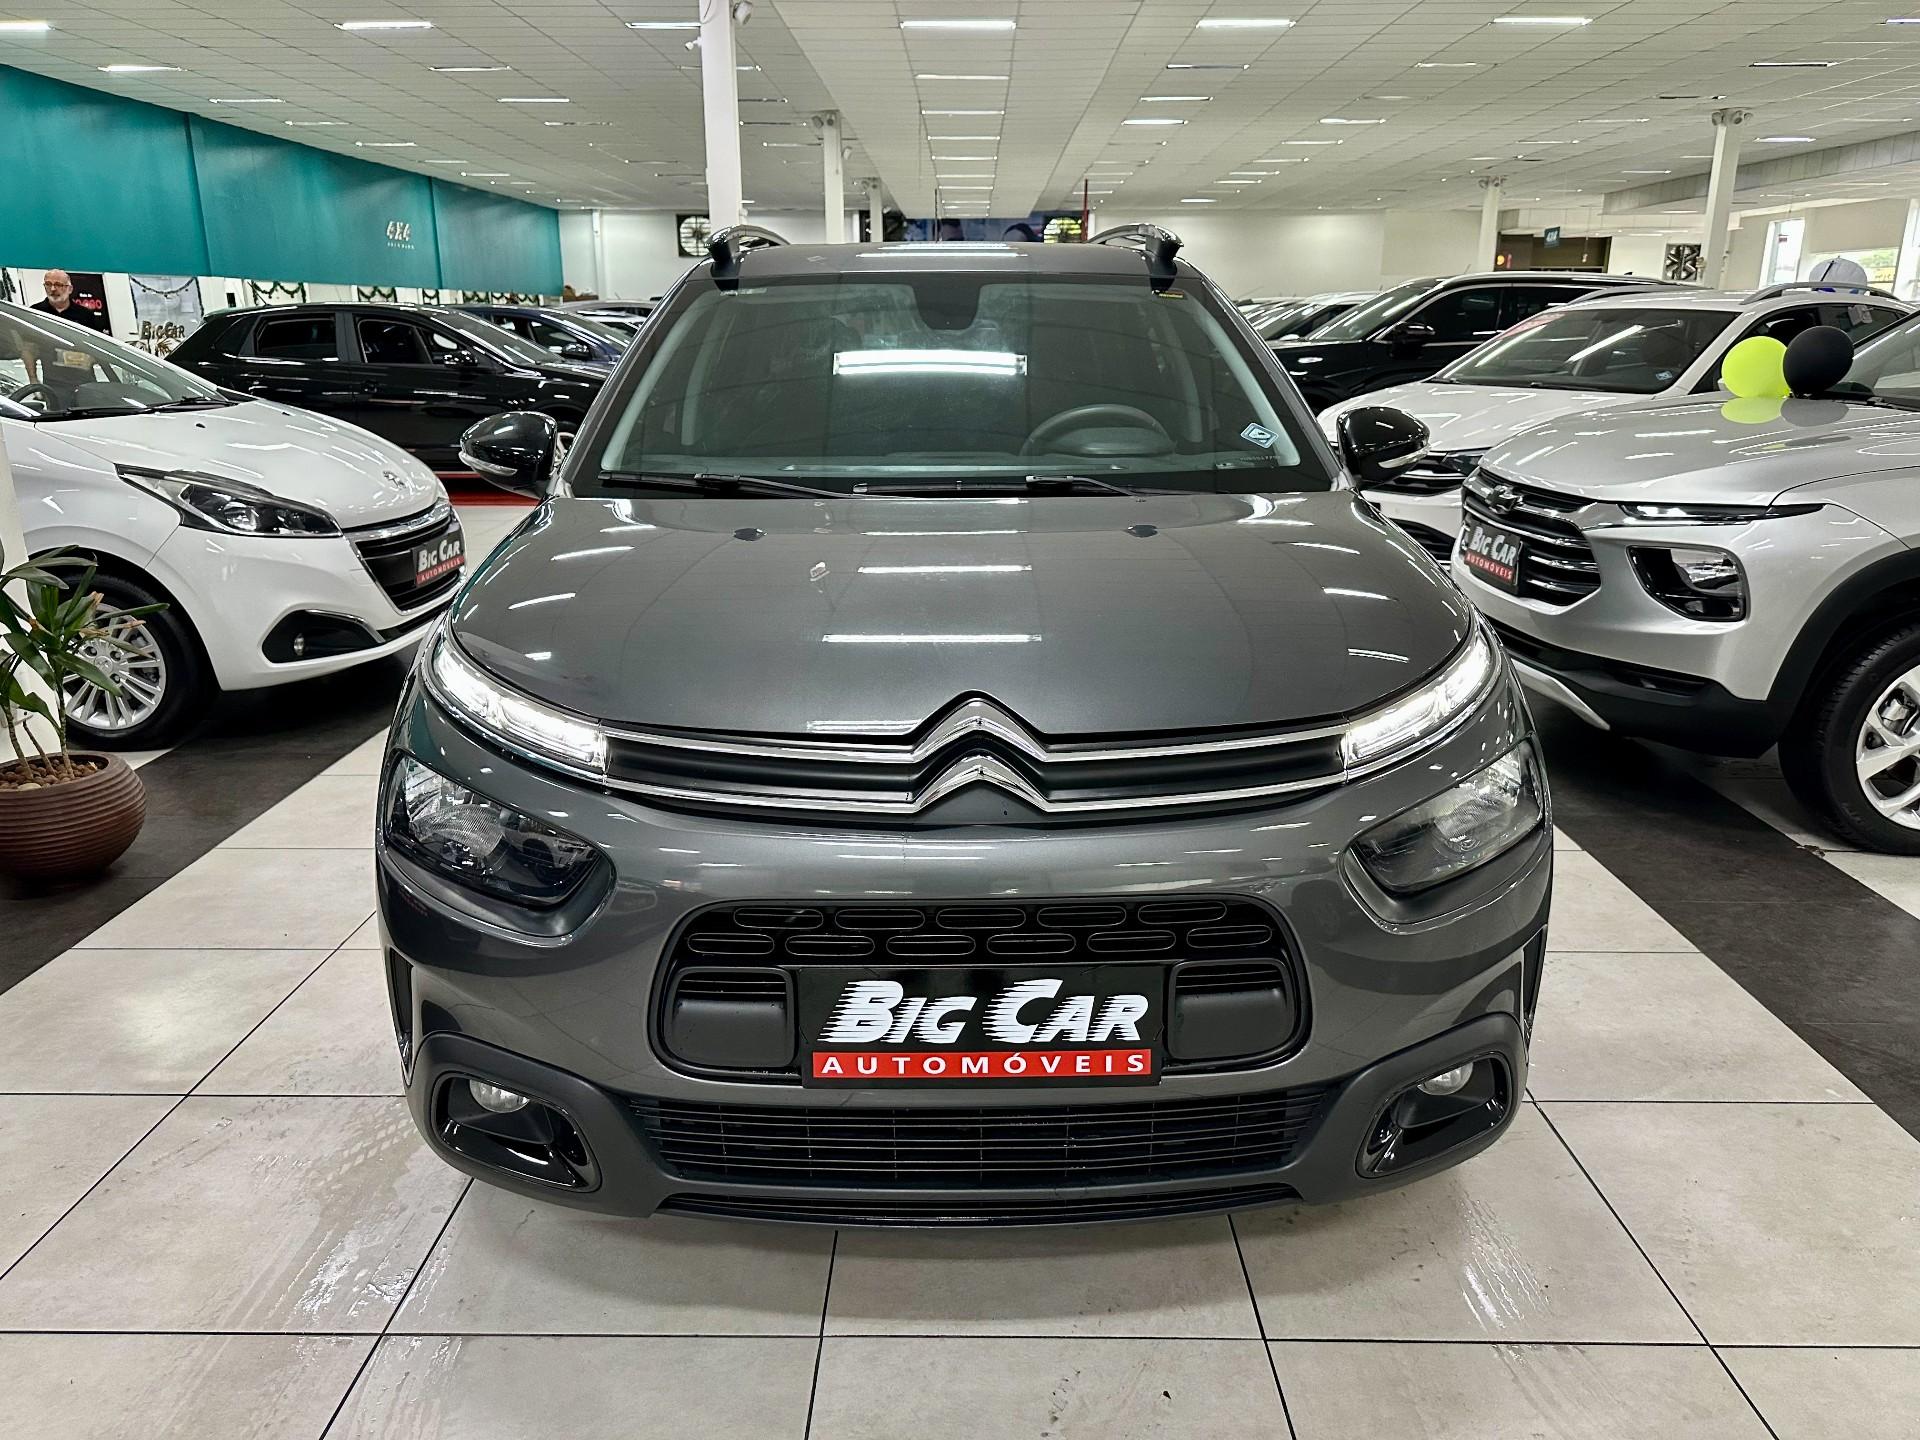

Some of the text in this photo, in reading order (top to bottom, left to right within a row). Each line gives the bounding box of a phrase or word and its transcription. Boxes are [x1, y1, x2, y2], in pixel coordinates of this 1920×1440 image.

[418, 539, 461, 573] BIG CAR
[1468, 526, 1517, 567] BIG CAR
[816, 978, 1149, 1044] BIG CAR
[821, 1052, 1144, 1075] AUTOMÓVEIS
